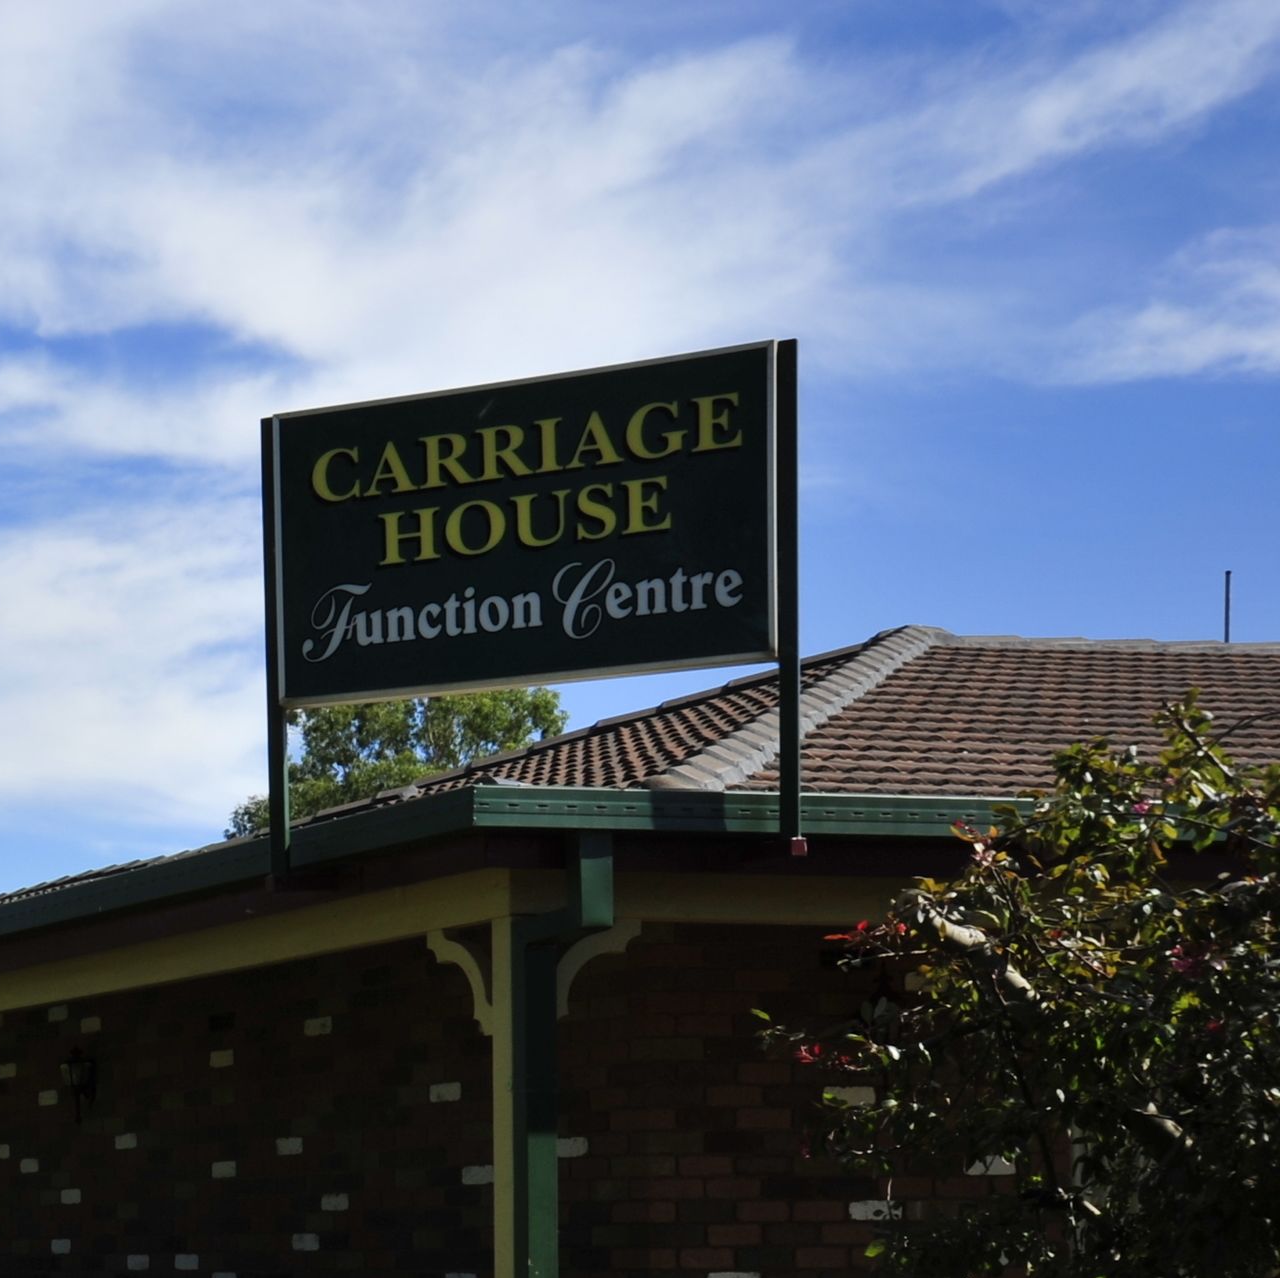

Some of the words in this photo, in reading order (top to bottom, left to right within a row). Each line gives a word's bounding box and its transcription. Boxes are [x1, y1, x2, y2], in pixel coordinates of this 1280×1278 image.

[311, 391, 744, 502] CARRIAGE
[378, 475, 673, 567] HOUSE
[301, 582, 543, 663] Function
[552, 557, 745, 640] Centre
